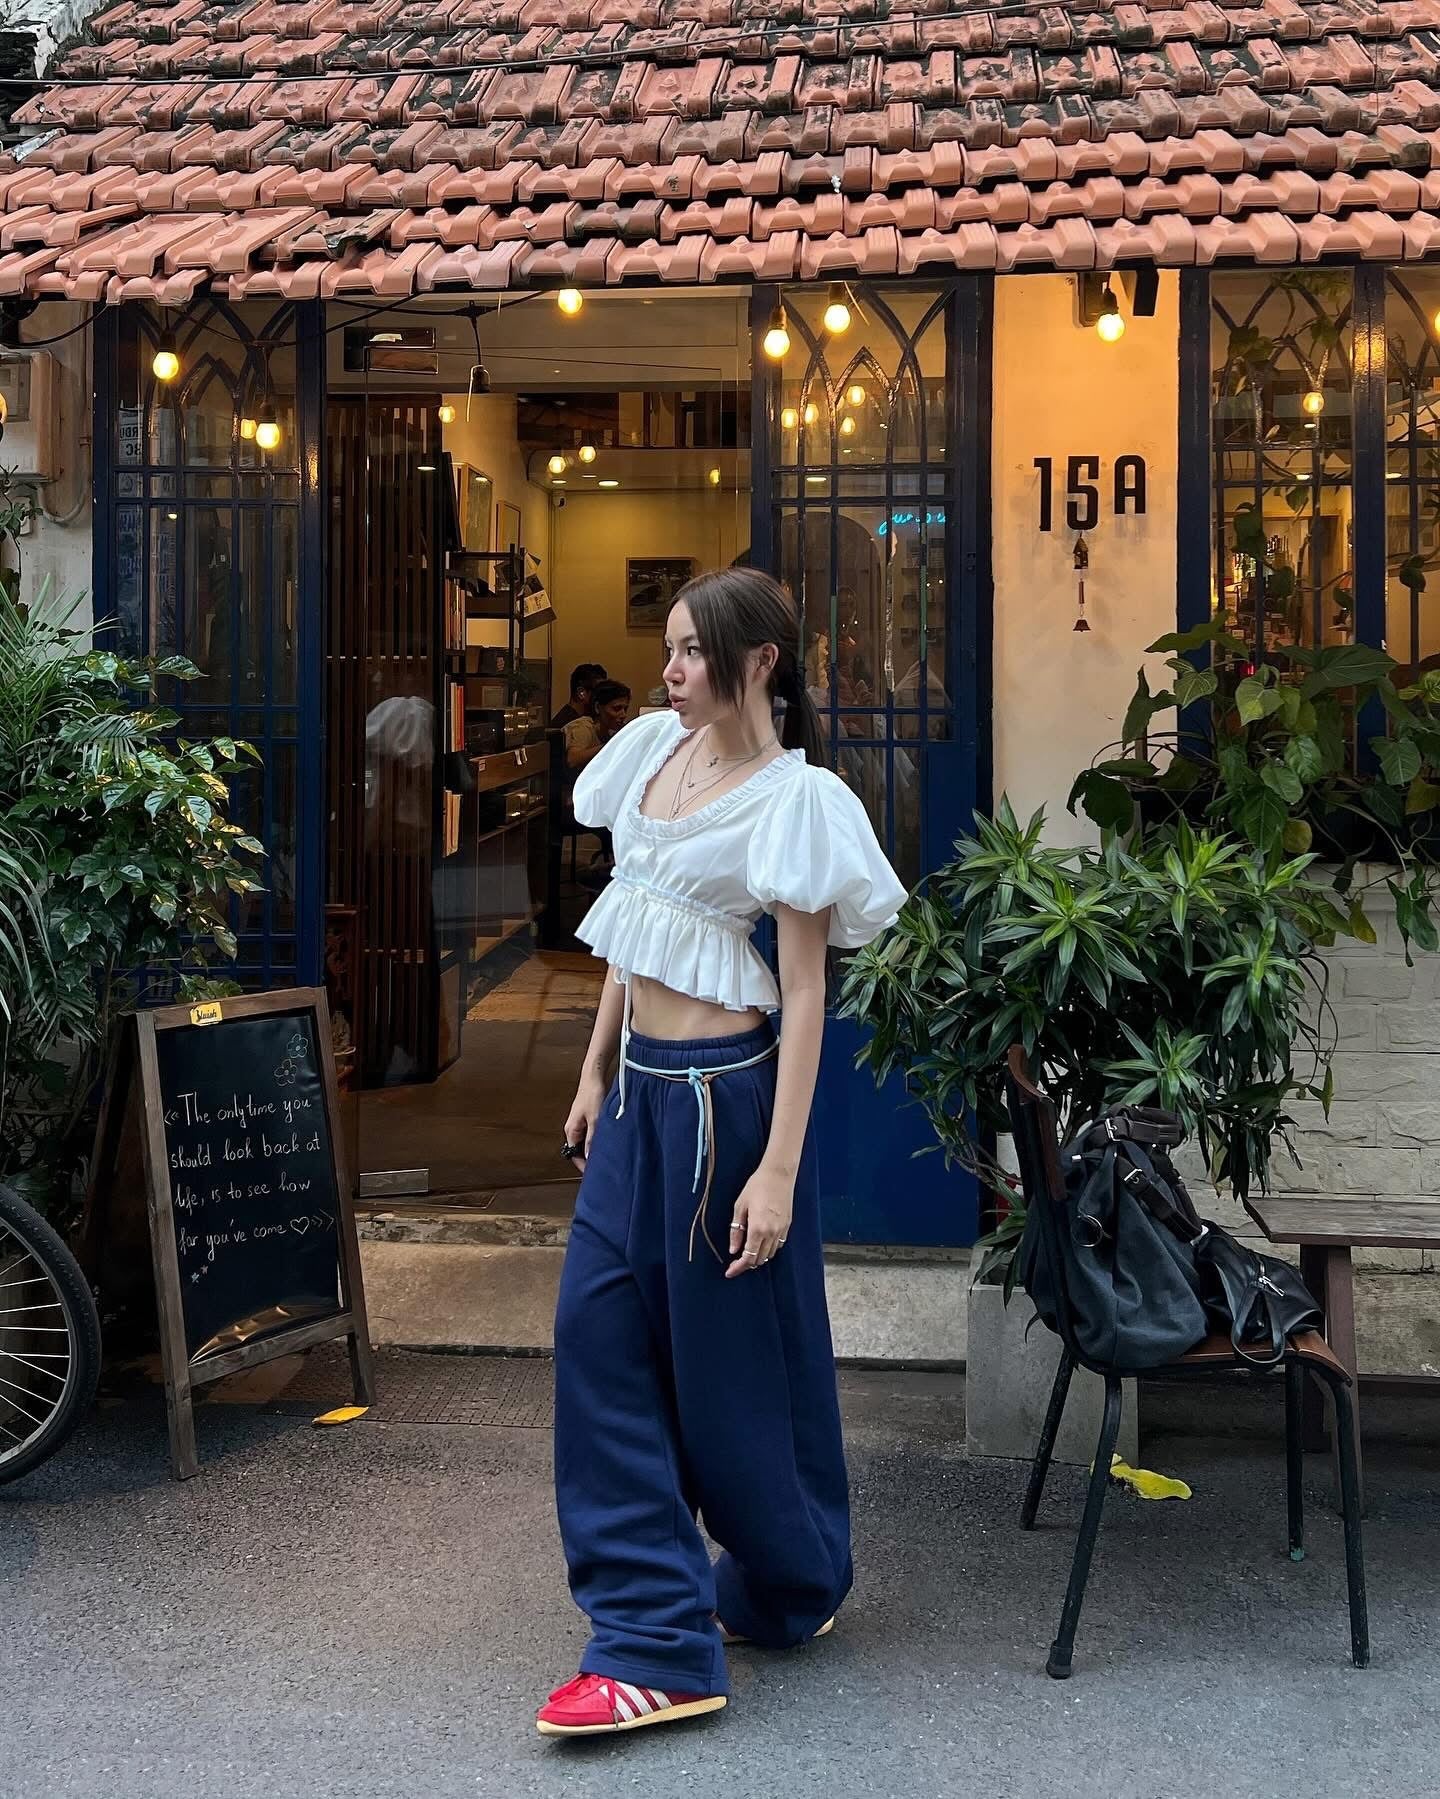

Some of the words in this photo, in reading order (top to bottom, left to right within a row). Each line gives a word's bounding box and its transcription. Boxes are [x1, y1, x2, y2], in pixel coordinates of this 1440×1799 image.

[1033, 454, 1147, 532] 15A
[283, 1097, 312, 1124] you
[171, 1143, 212, 1169] should
[222, 1138, 254, 1161] look
[262, 1132, 300, 1157] back
[306, 1131, 321, 1151] at
[211, 1188, 222, 1203] is
[227, 1181, 242, 1199] to
[247, 1183, 271, 1197] see
[279, 1171, 311, 1192] how
[178, 1226, 199, 1256] far
[206, 1218, 247, 1262] you've
[253, 1224, 288, 1238] come
